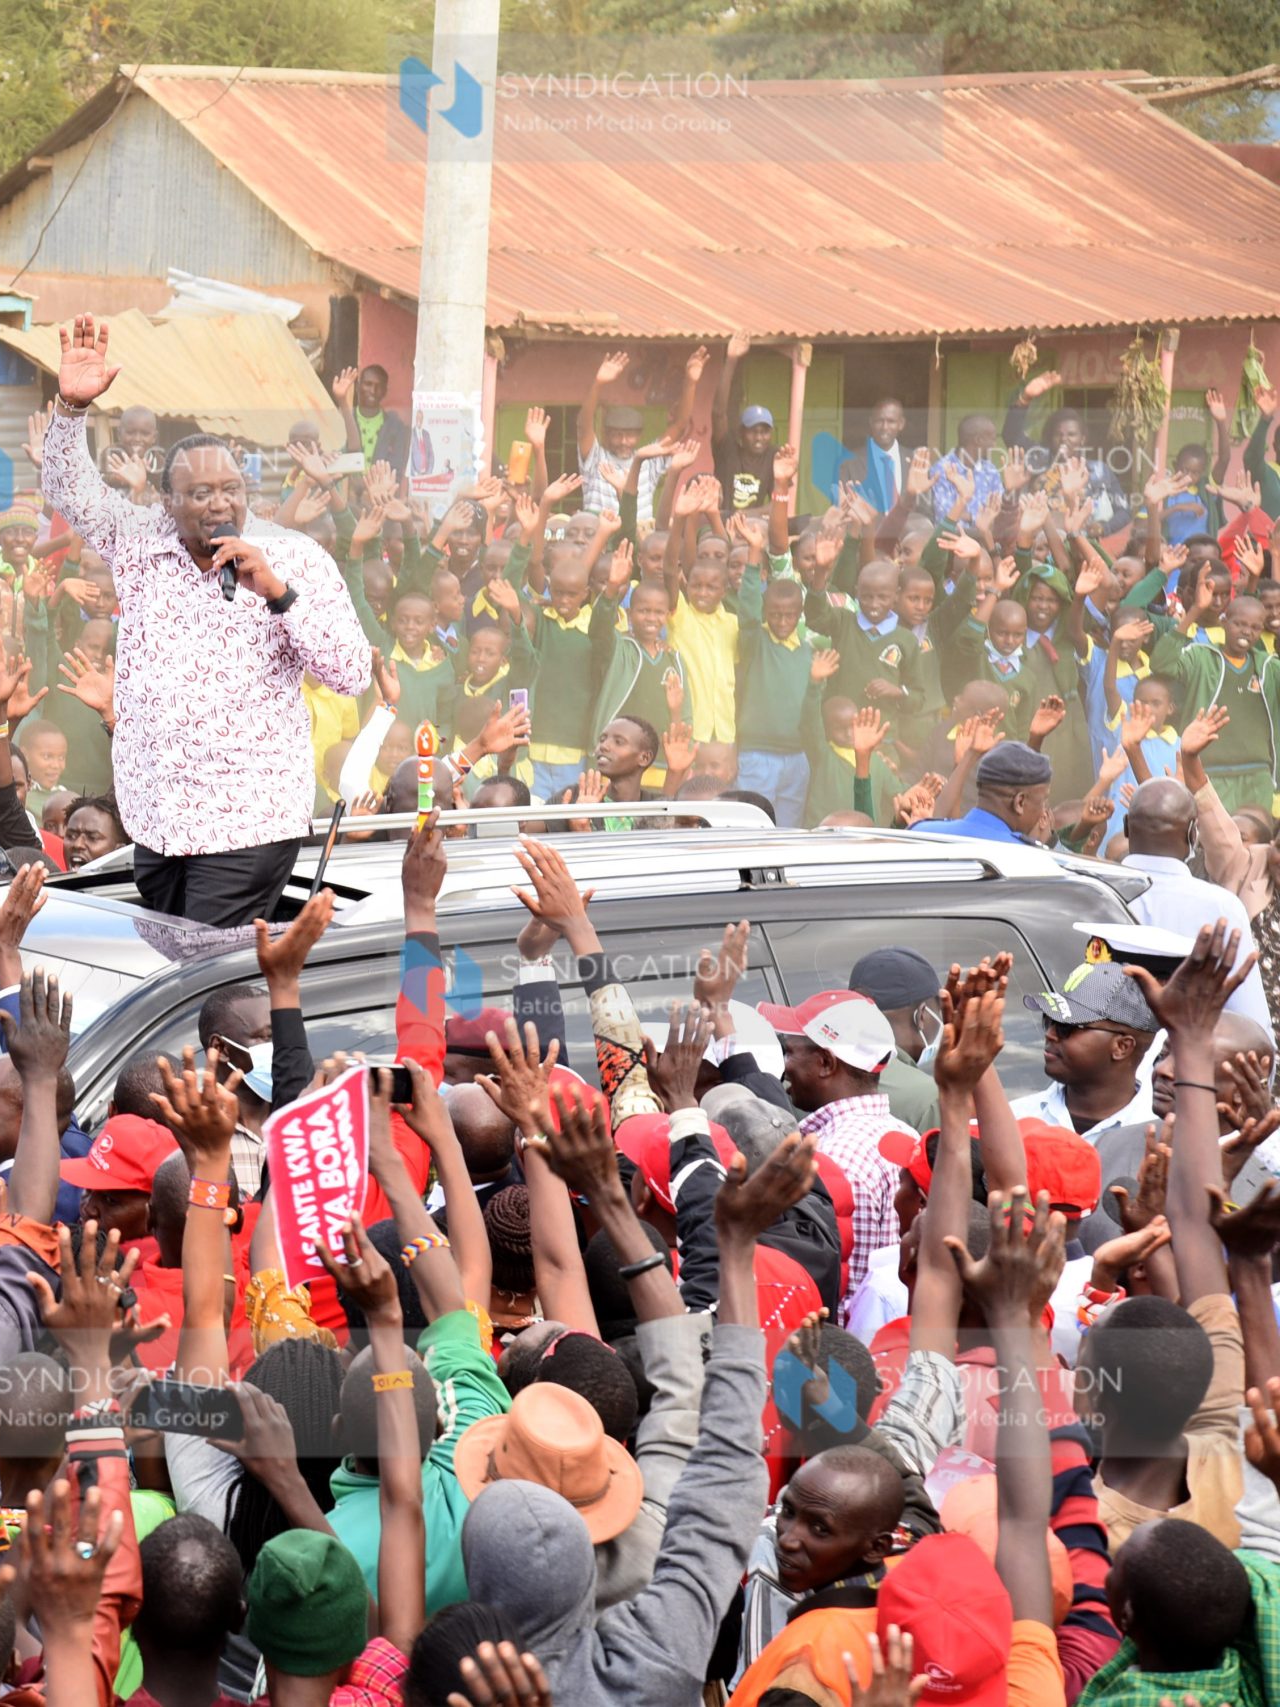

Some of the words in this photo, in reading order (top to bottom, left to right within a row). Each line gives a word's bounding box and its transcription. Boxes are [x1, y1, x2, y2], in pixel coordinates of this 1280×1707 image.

[281, 1117, 312, 1178] KWA
[306, 1103, 346, 1189] BORA
[291, 1178, 324, 1268] ASANTE
